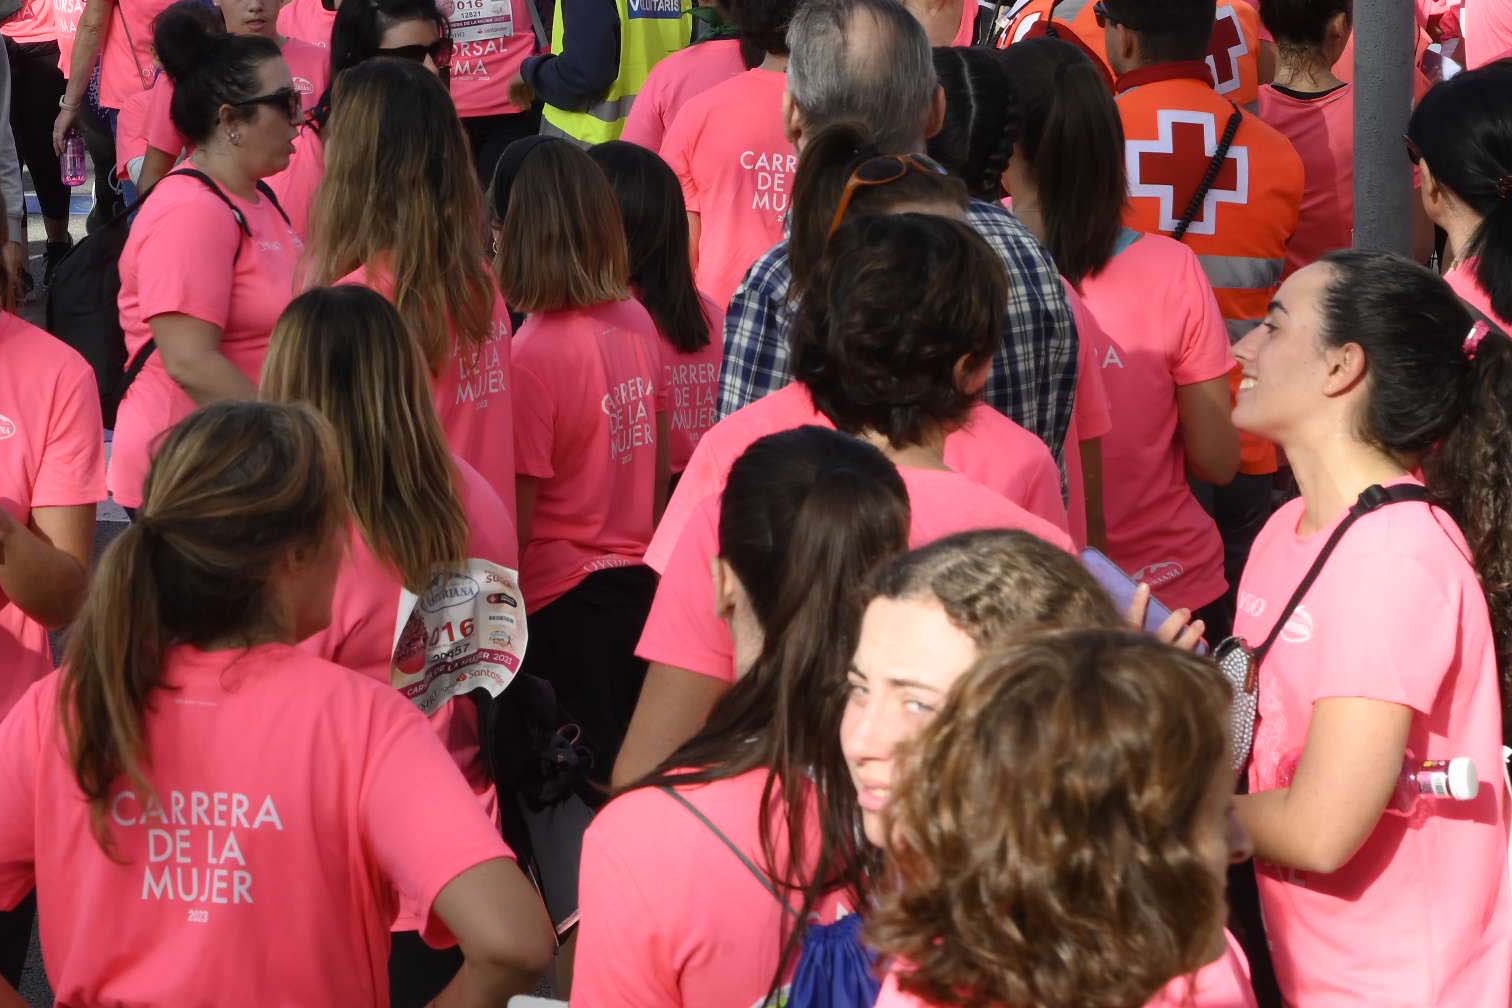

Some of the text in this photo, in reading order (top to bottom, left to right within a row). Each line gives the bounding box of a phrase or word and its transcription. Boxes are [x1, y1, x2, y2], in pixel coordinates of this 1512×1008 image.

[456, 0, 484, 10] 016
[460, 10, 482, 19] 12821
[740, 150, 796, 171] CARR
[758, 172, 785, 192] DE
[485, 345, 500, 370] LA
[456, 370, 506, 405] MUJER
[675, 388, 714, 407] DE LA
[609, 402, 648, 434] DE LA
[611, 424, 653, 460] MUJER
[111, 791, 283, 831] CARRERA
[148, 828, 246, 865] DE LA
[141, 866, 253, 904] MUJER
[188, 909, 209, 923] 2023
